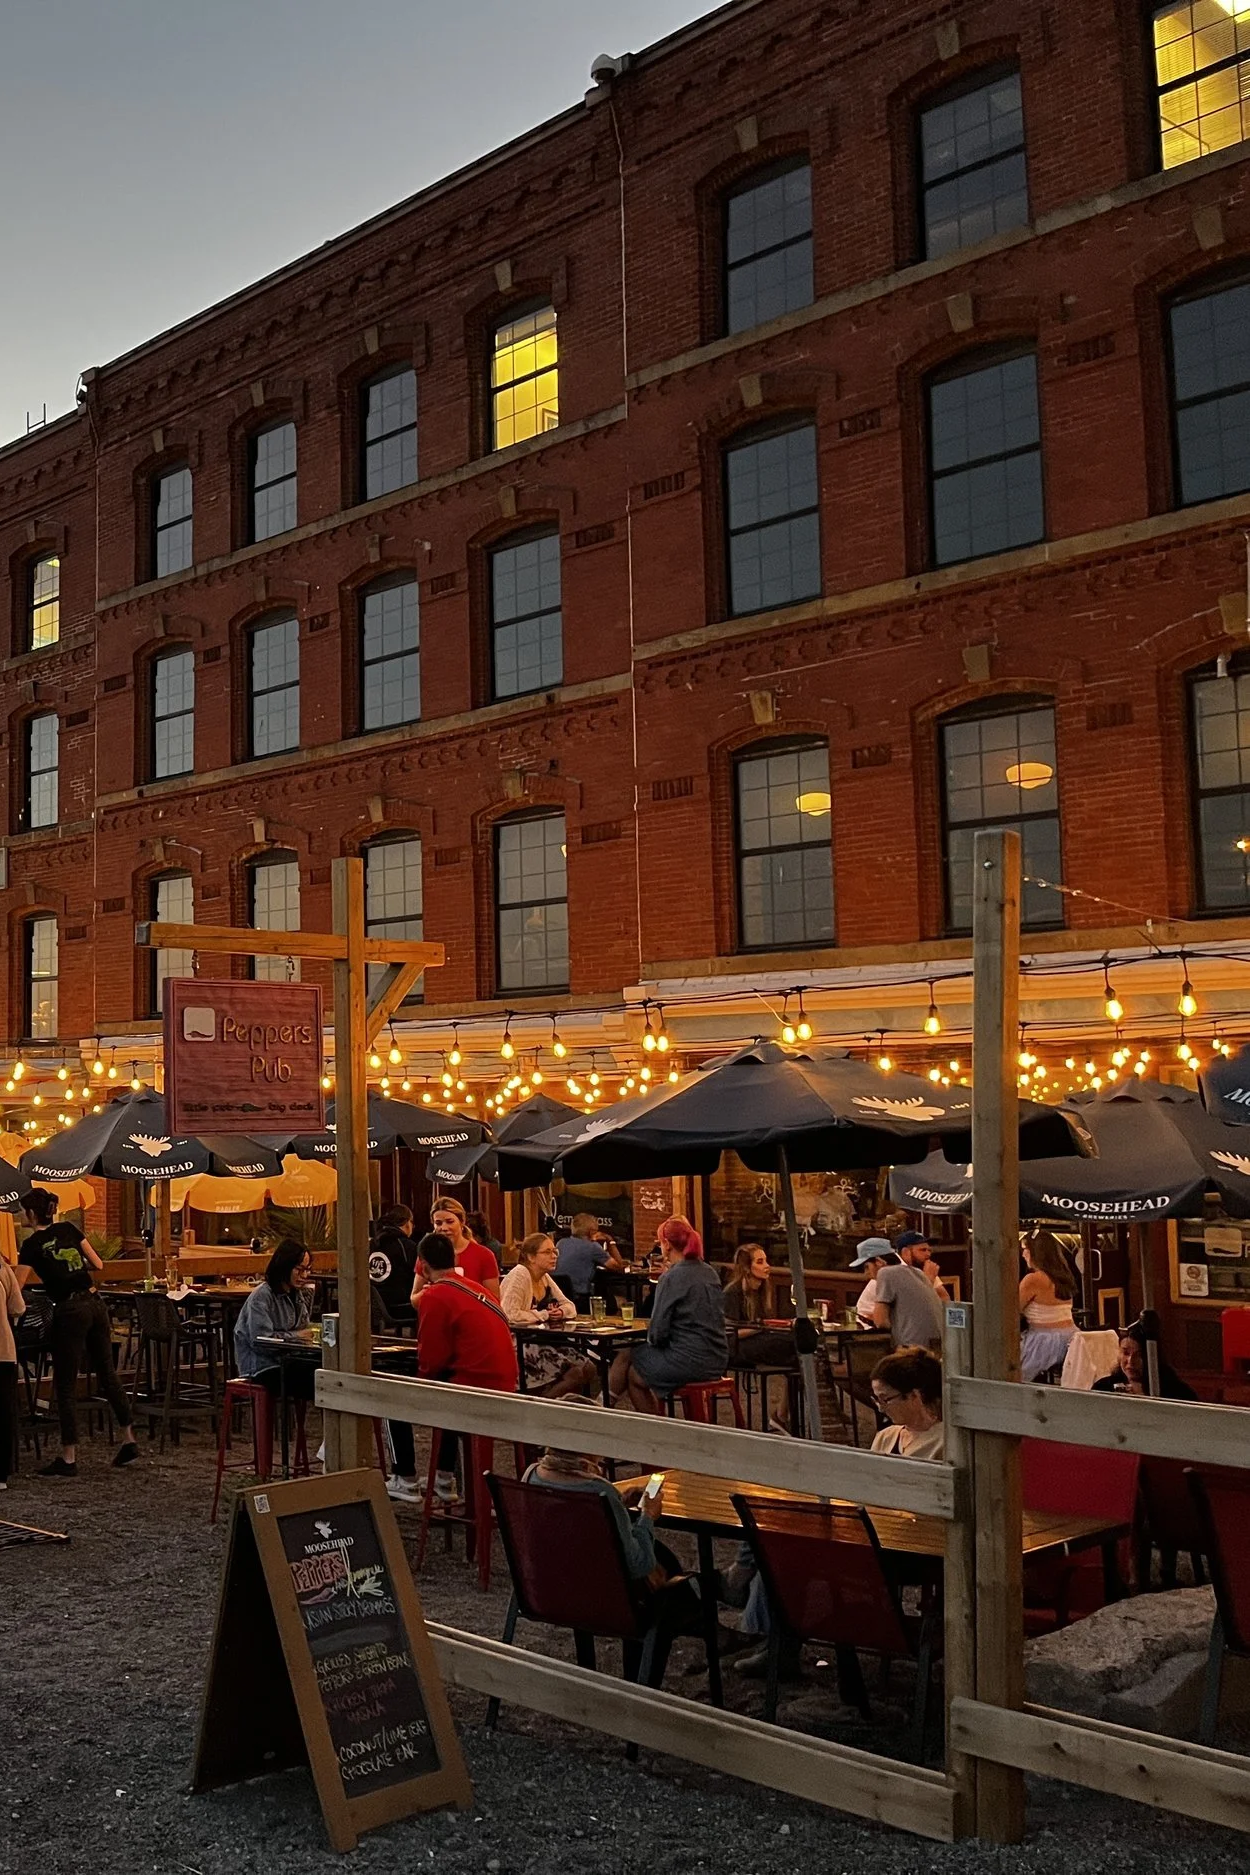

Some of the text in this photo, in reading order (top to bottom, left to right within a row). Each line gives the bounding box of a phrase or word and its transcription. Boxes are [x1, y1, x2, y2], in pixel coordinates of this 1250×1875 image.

[222, 1016, 312, 1051] Peppers
[250, 1056, 292, 1083] Pub
[417, 1132, 469, 1145] MOOSEHEAD
[121, 1161, 194, 1176] MOOSEHEAD
[1041, 1193, 1171, 1213] MOOSEHEAD
[304, 1536, 355, 1554] MOOSEHEAD
[341, 1741, 419, 1781] CHOCOLATE BAR
